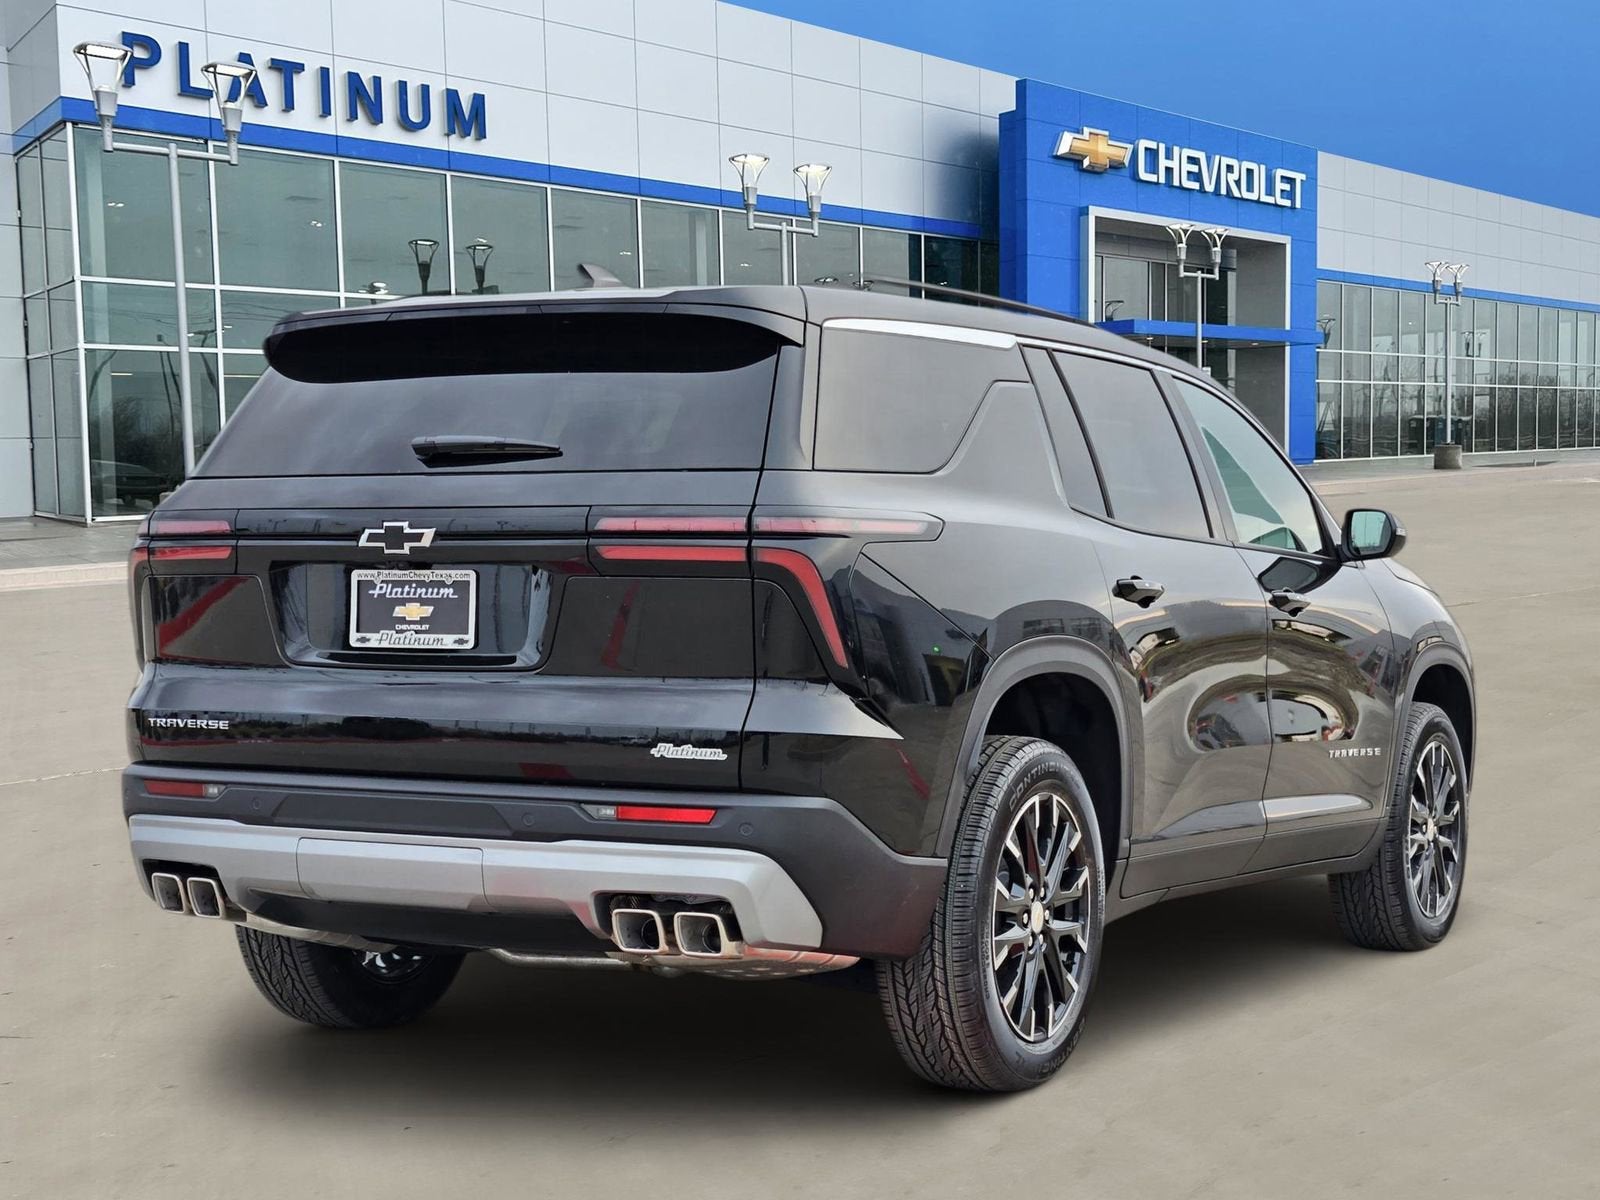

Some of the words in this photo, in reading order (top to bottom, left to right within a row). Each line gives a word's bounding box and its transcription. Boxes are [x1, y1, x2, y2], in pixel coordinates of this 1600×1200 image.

[121, 31, 487, 141] PLATINUM
[1136, 139, 1306, 209] CHEVROLET
[357, 571, 471, 582] www.PlatinumChevyTexas.com
[368, 583, 459, 599] Platinum
[375, 631, 448, 646] Platinum
[148, 718, 229, 730] TRAVERSE
[650, 743, 728, 760] Platinum
[1329, 747, 1381, 759] TRAVERSE
